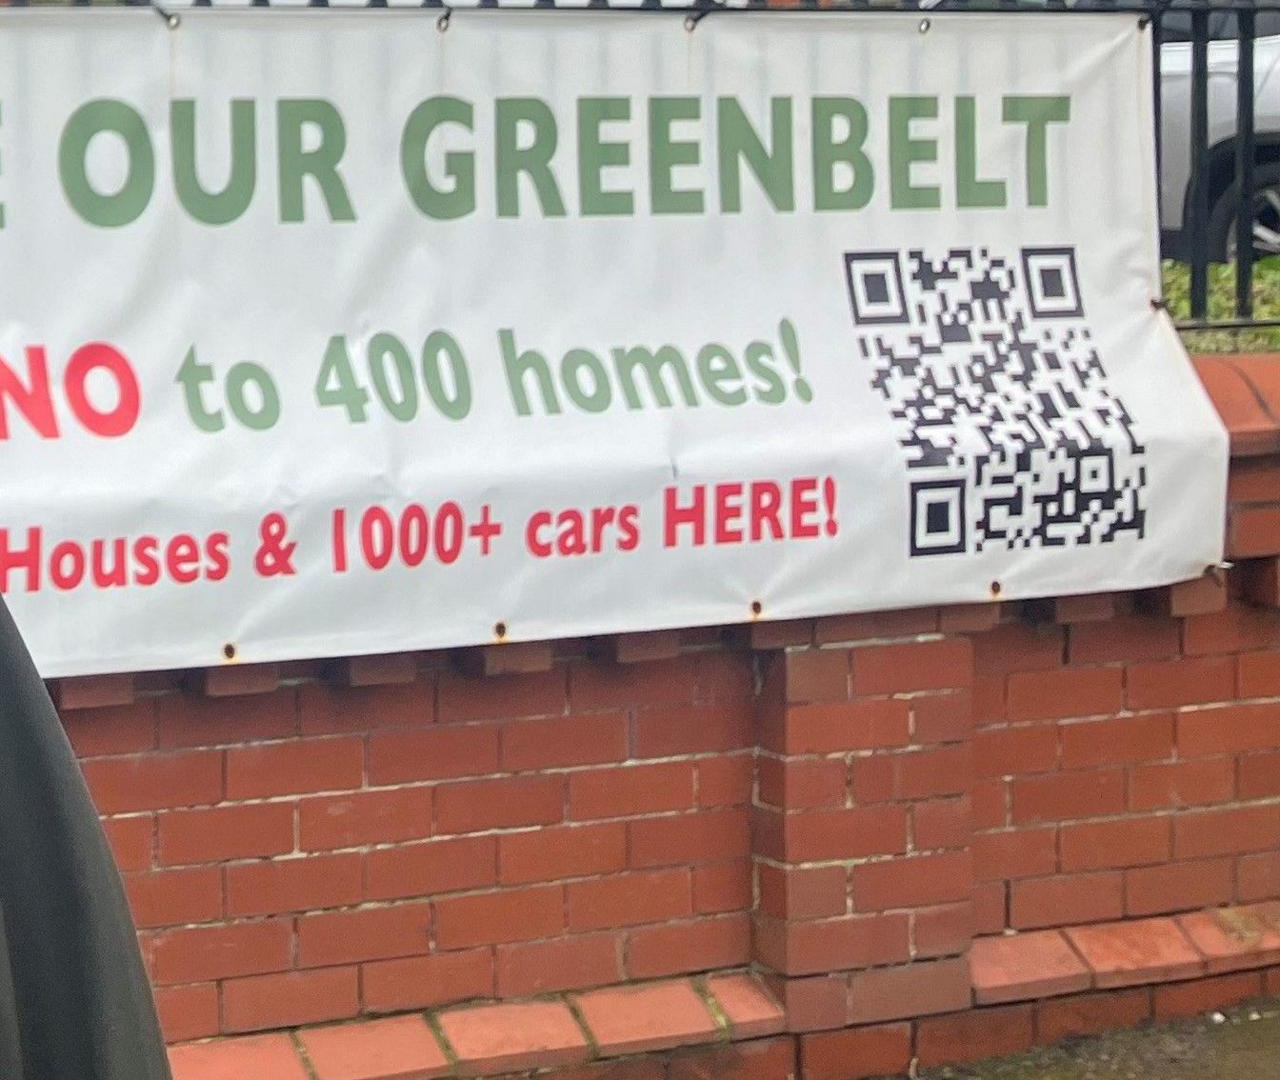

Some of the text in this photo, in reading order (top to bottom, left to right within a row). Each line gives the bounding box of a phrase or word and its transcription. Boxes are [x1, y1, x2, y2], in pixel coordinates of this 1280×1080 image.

[57, 98, 357, 229] OUR
[401, 94, 1072, 220] GREENBELT
[175, 345, 282, 434] to
[313, 330, 472, 425] 400
[497, 319, 814, 417] homes!
[255, 512, 297, 577] &
[332, 501, 502, 573] 1000+
[524, 503, 641, 559] cars
[663, 476, 839, 549] HERE!
